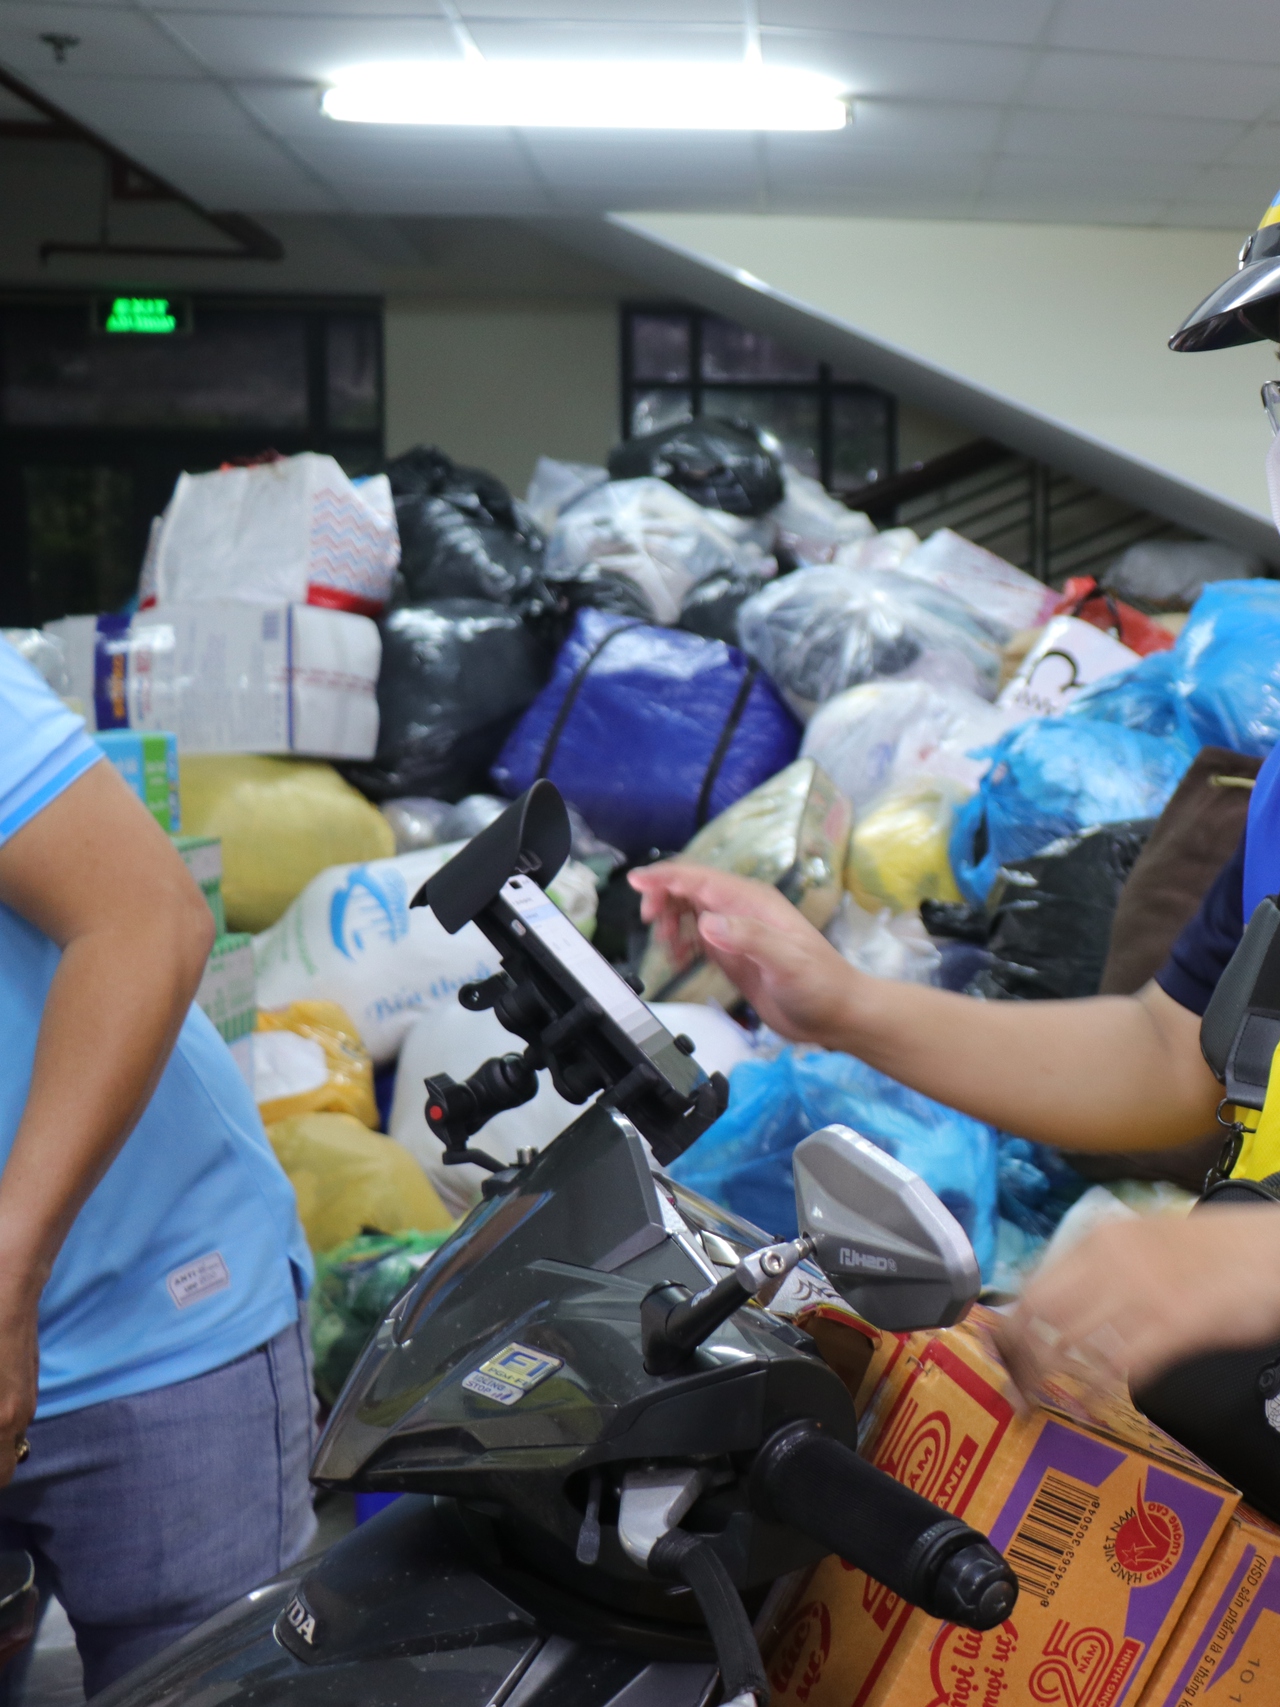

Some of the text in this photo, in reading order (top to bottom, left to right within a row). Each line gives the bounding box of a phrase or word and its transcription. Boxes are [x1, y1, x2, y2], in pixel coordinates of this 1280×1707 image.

[498, 1351, 550, 1378] FI
[466, 1380, 492, 1393] STOP
[1110, 1506, 1137, 1533] NAM
[1148, 1502, 1169, 1516] CAO
[1040, 1500, 1100, 1608] 8 934563 305048
[1110, 1561, 1142, 1585] HÀNG
[1185, 1554, 1268, 1697] (HSD sản phẩm là 5 tháng
[1077, 1643, 1099, 1675] NĂM
[1110, 1648, 1135, 1683] HÀNH
